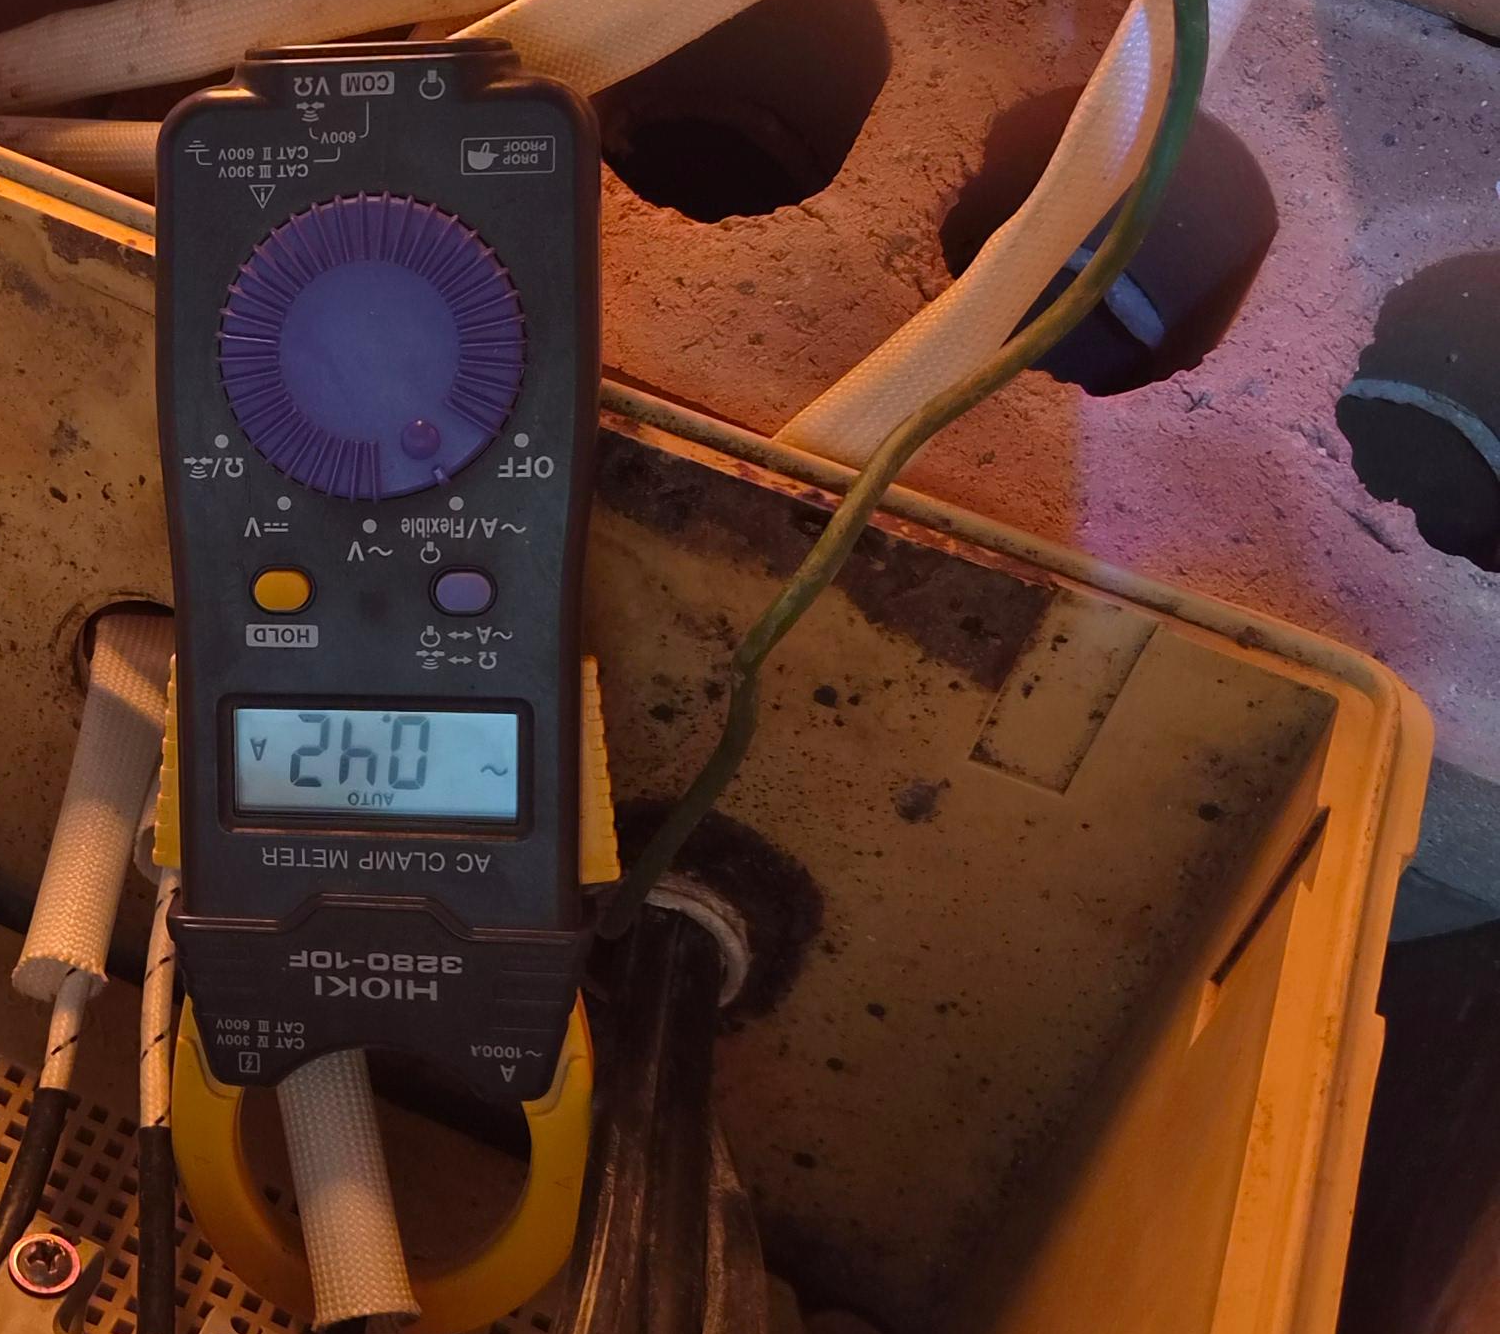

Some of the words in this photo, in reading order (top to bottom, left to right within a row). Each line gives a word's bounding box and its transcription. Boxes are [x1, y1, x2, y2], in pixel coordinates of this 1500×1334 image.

[346, 74, 389, 92] COM
[321, 131, 355, 144] 600V
[279, 147, 308, 159] CAT
[503, 141, 547, 152] PROOF
[219, 148, 254, 160] 600V
[503, 153, 538, 164] DROP
[219, 166, 254, 178] 300V
[279, 165, 308, 177] CAT
[498, 456, 553, 478] OFF
[254, 629, 309, 643] HOLD
[250, 738, 267, 760] A
[290, 714, 430, 790] 0.42
[348, 793, 394, 806] AUTO
[262, 847, 348, 868] METER
[359, 851, 445, 871] CLAMP
[456, 853, 491, 873] AC
[289, 950, 463, 973] 3280-10F
[315, 976, 437, 1001] HIOKI
[215, 1019, 250, 1031] 600V
[275, 1022, 305, 1033] CAT
[216, 1034, 250, 1046] 300V
[275, 1037, 305, 1048] CAT
[500, 1065, 516, 1081] A
